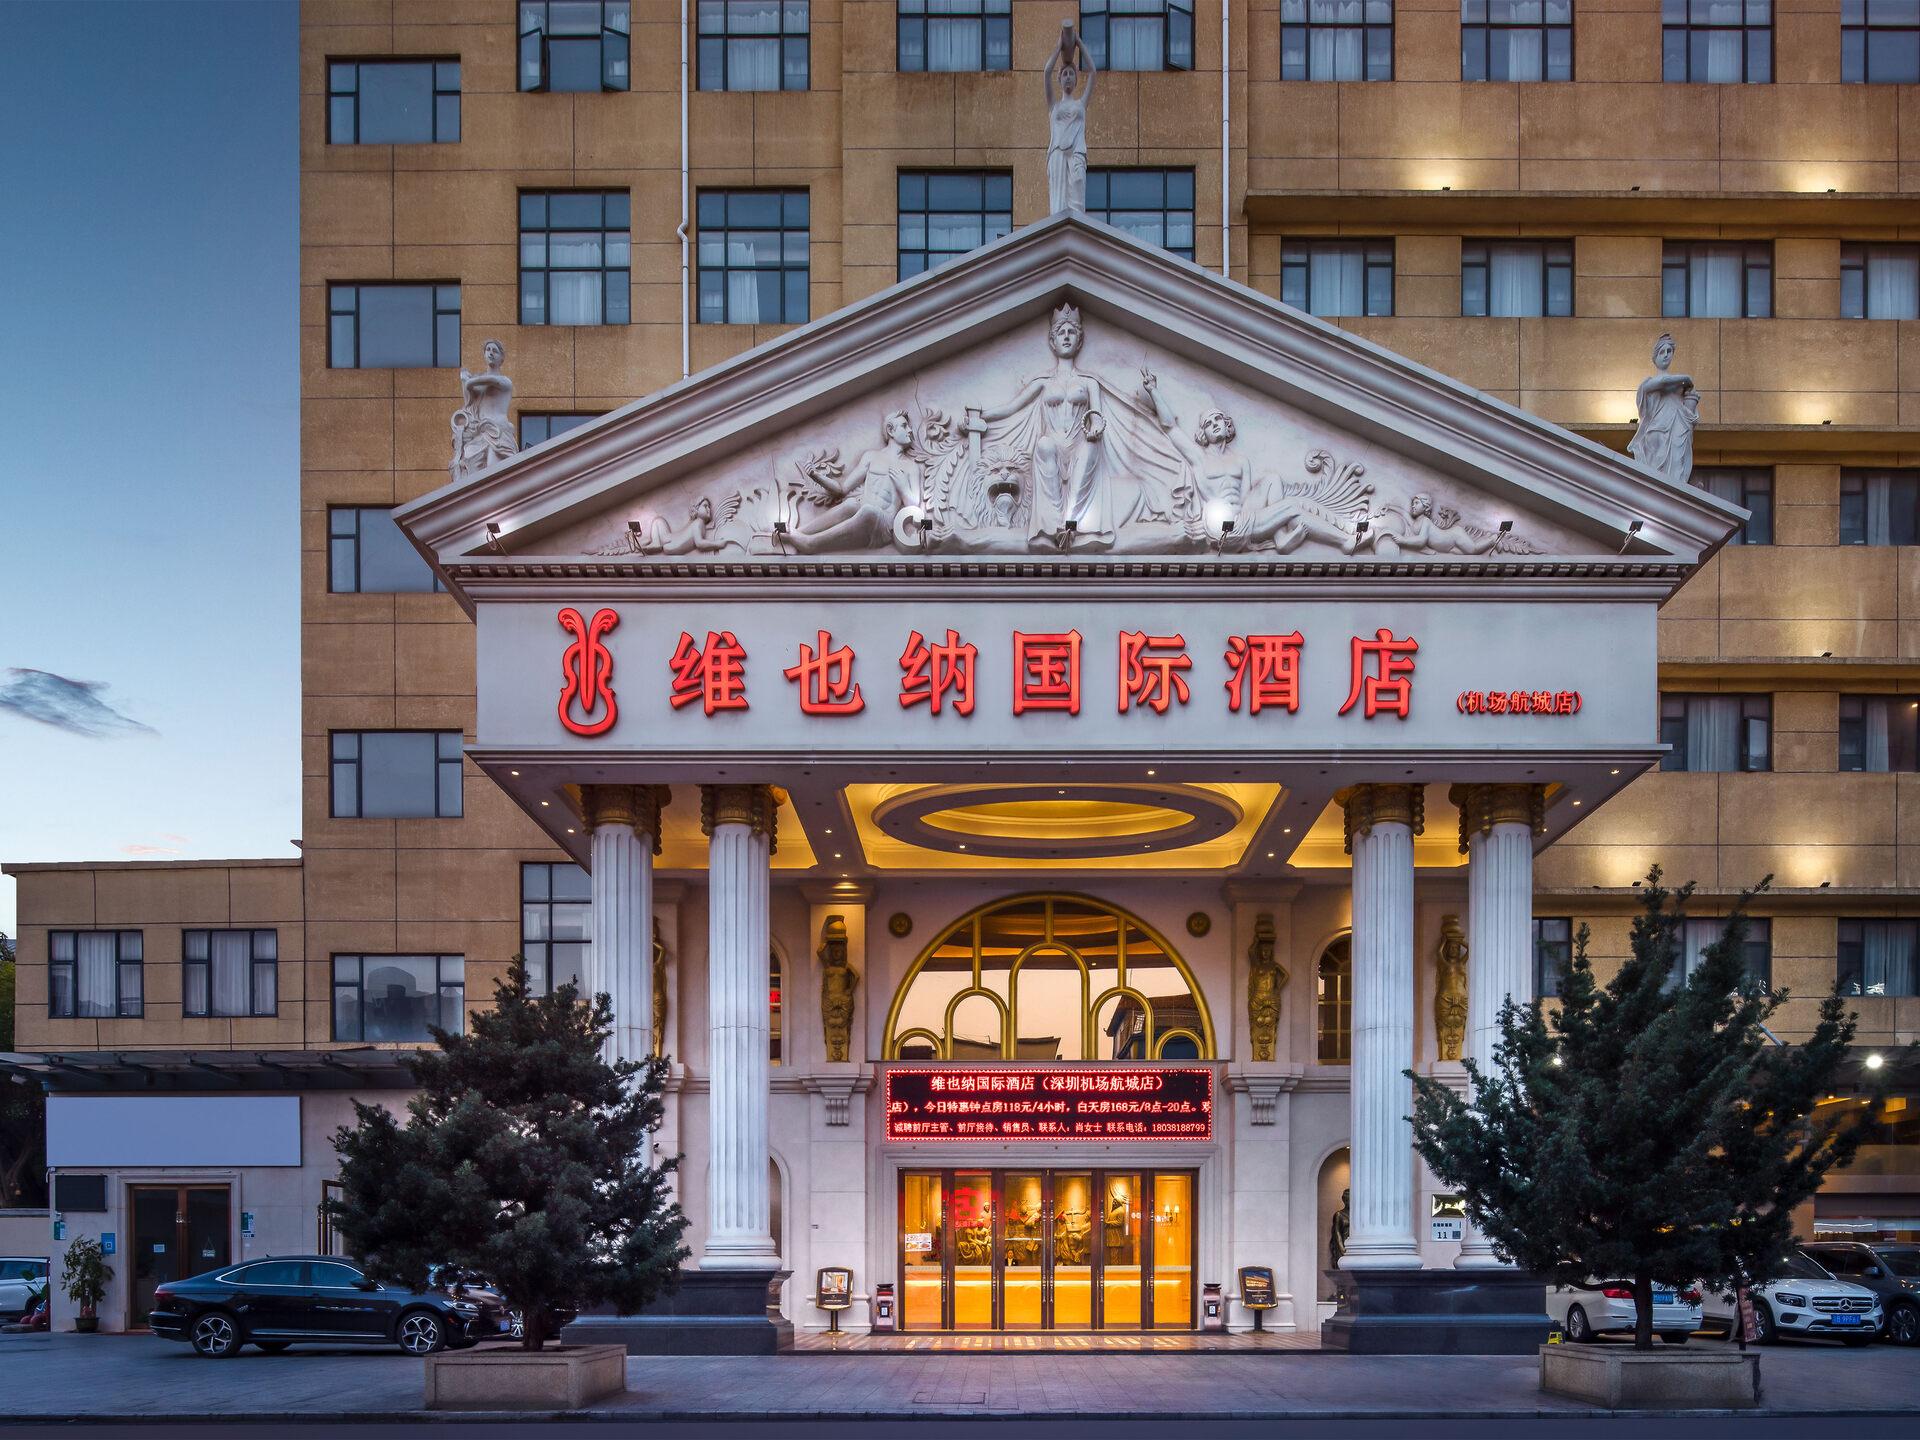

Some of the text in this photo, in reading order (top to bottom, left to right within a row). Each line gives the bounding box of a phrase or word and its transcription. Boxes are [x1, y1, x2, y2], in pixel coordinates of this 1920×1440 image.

[669, 628, 1418, 717] 维也纳国际酒店
[1457, 691, 1583, 714] （机场航城店）
[931, 1075, 1163, 1091] 维也纳国际酒店（深圳机场航城店）
